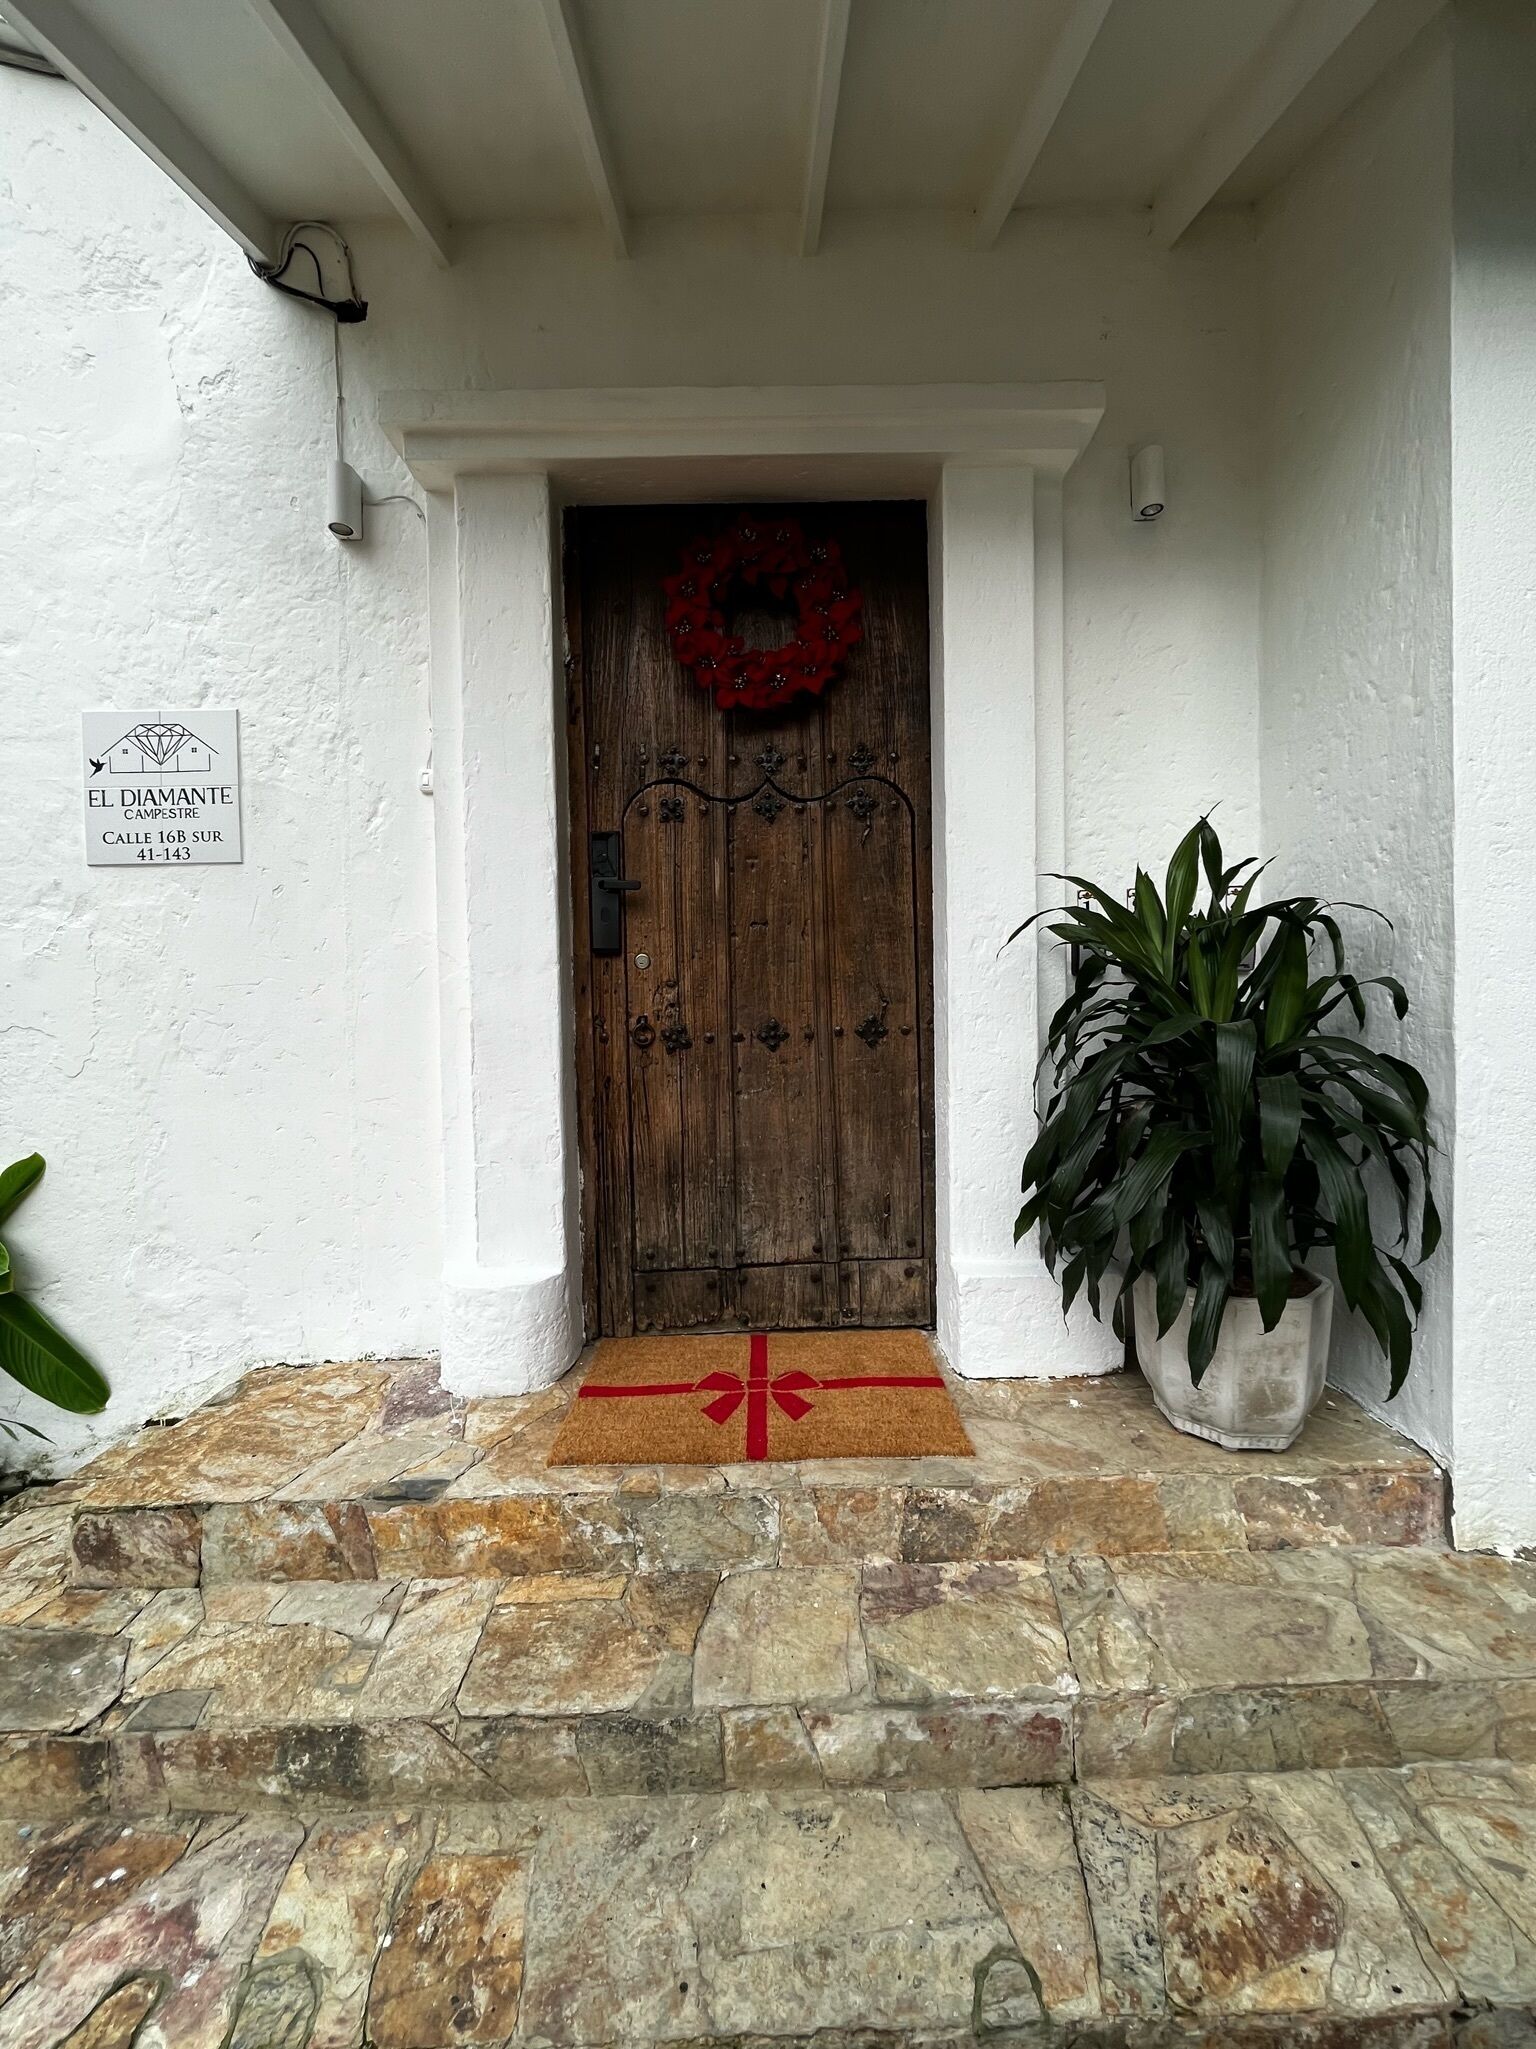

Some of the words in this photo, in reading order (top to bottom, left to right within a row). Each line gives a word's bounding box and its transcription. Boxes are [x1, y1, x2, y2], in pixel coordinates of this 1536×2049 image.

[88, 789, 115, 808] EL
[120, 787, 234, 807] DIAMANTE
[123, 807, 201, 820] CAMPESTRE
[102, 831, 153, 845] CALLE
[158, 829, 188, 844] 16B
[191, 830, 224, 843] SUR
[136, 846, 192, 861] 41-143
